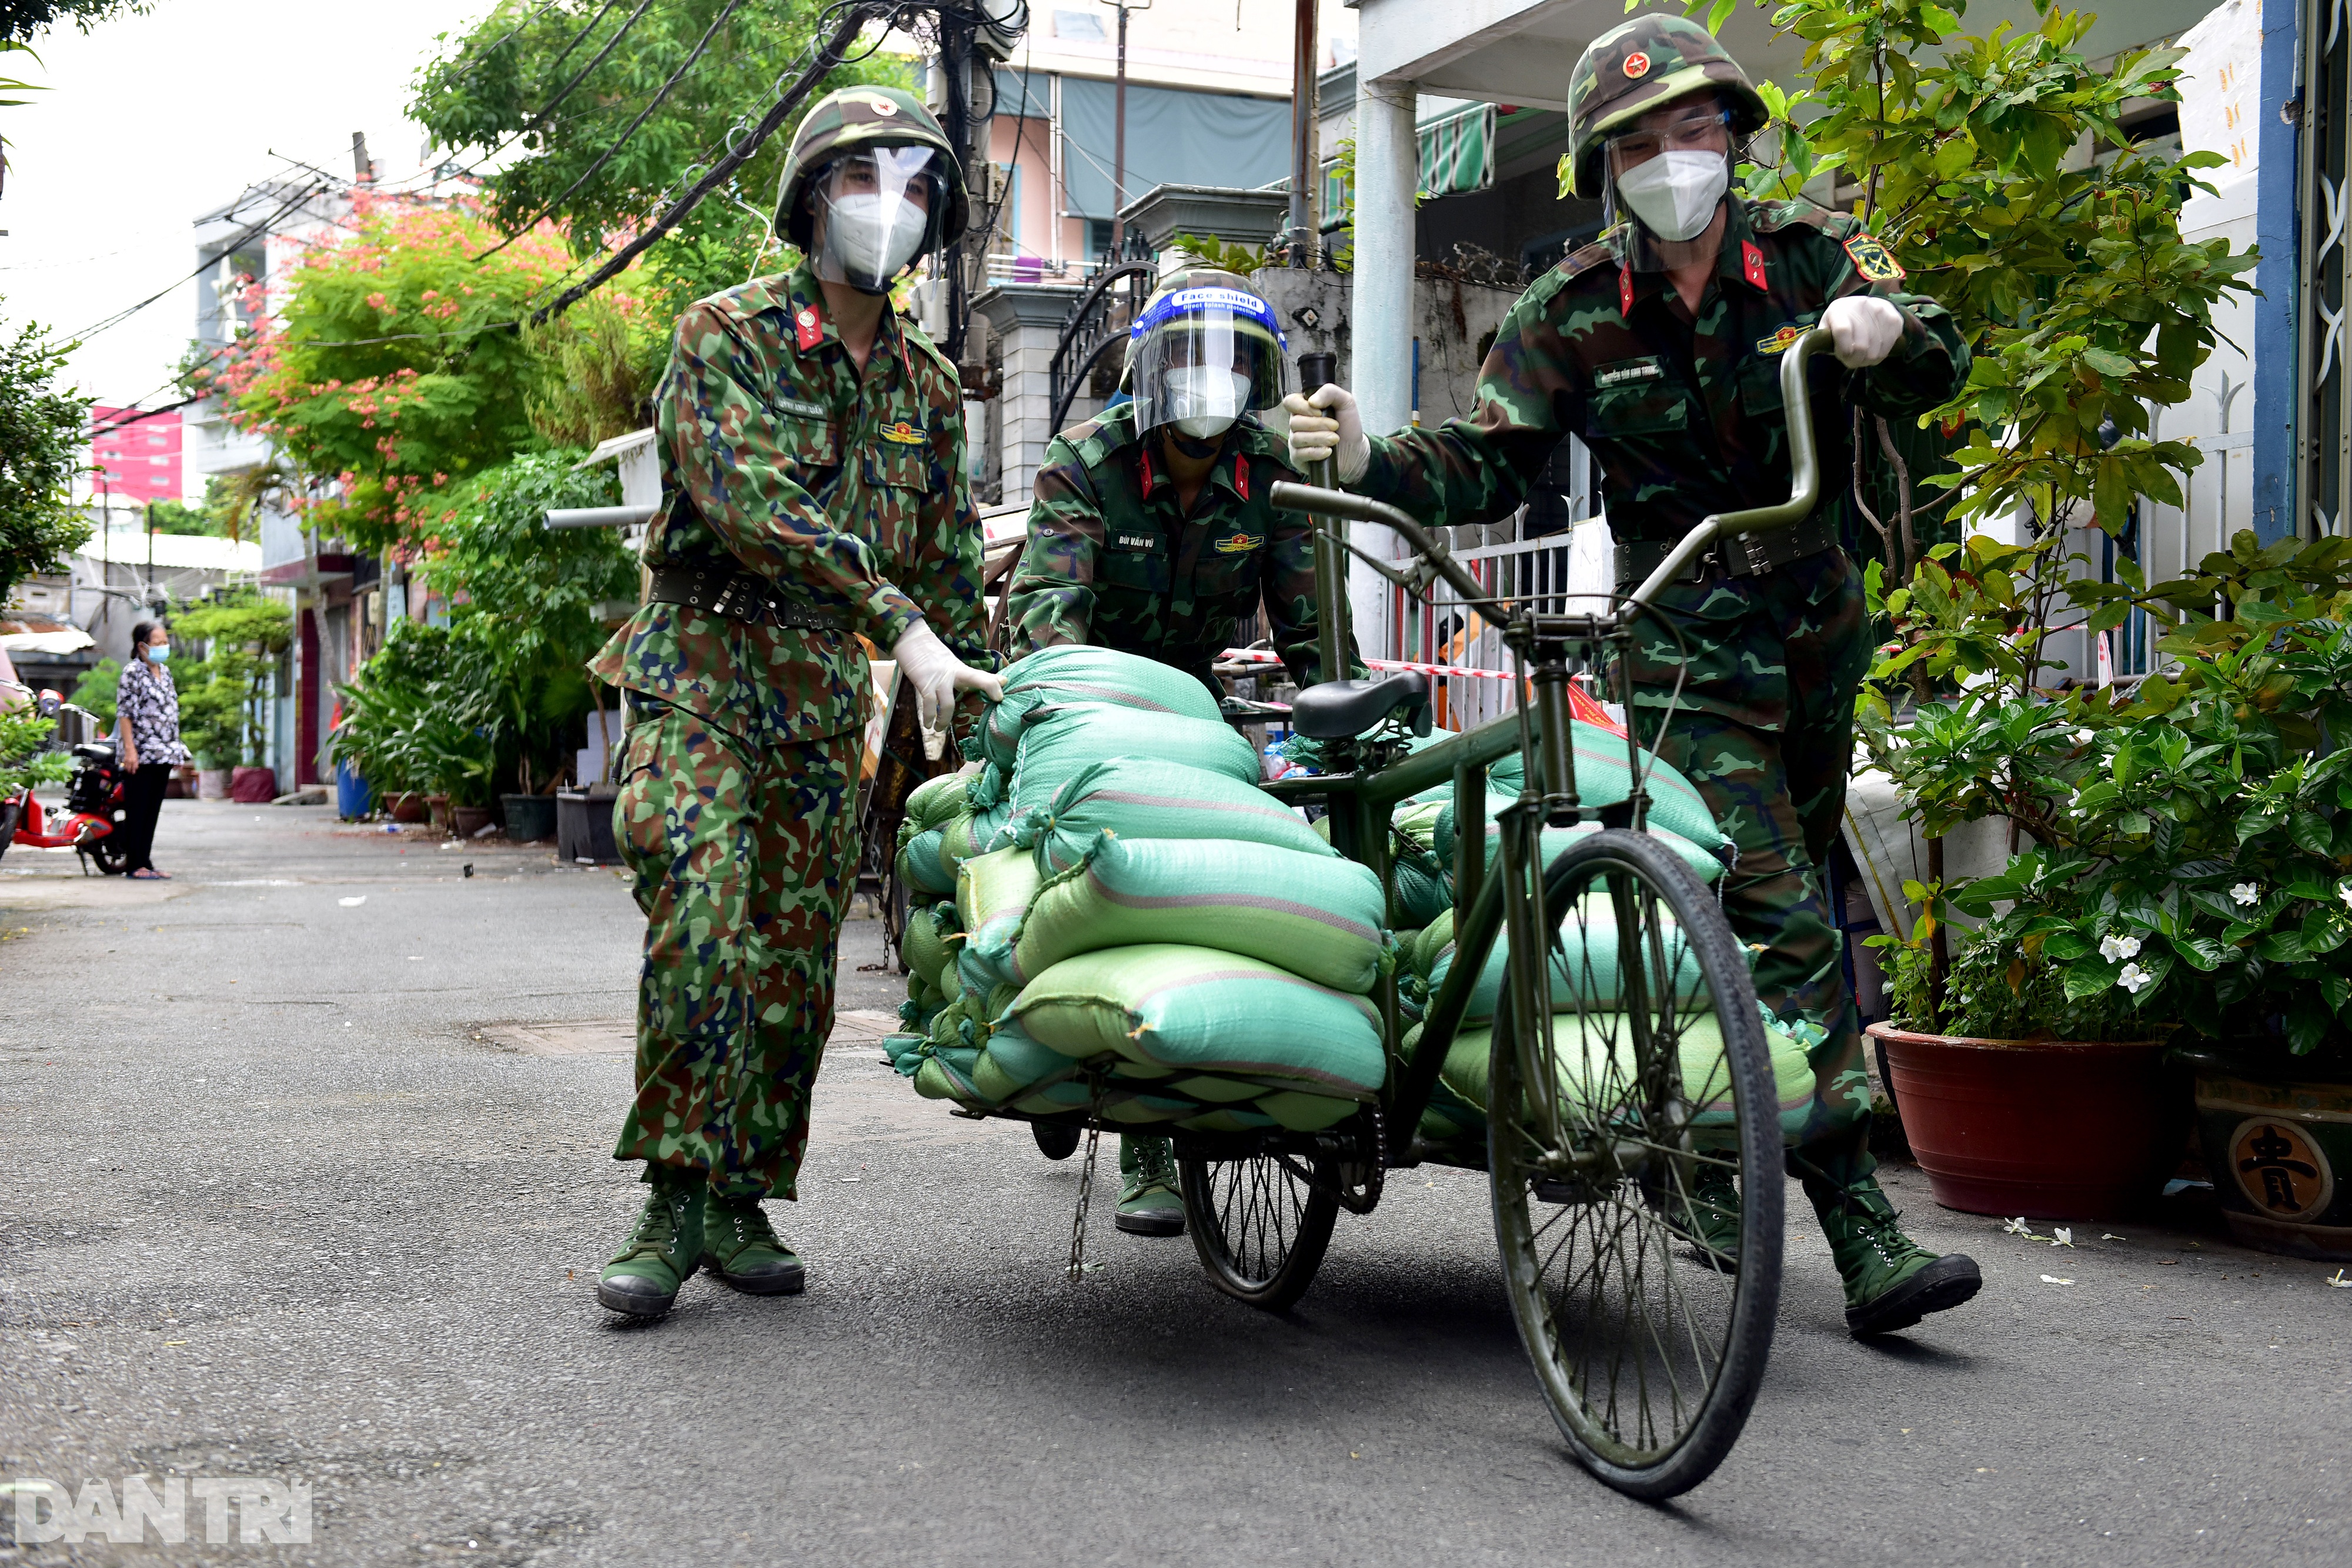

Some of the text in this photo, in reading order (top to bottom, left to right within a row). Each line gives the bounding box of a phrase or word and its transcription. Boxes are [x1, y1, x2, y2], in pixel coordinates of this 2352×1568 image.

[1181, 293, 1257, 308] Face shield
[1183, 302, 1202, 310] Direct
[1227, 303, 1257, 317] protection
[1119, 535, 1154, 547] BÙI VĂN VŨ
